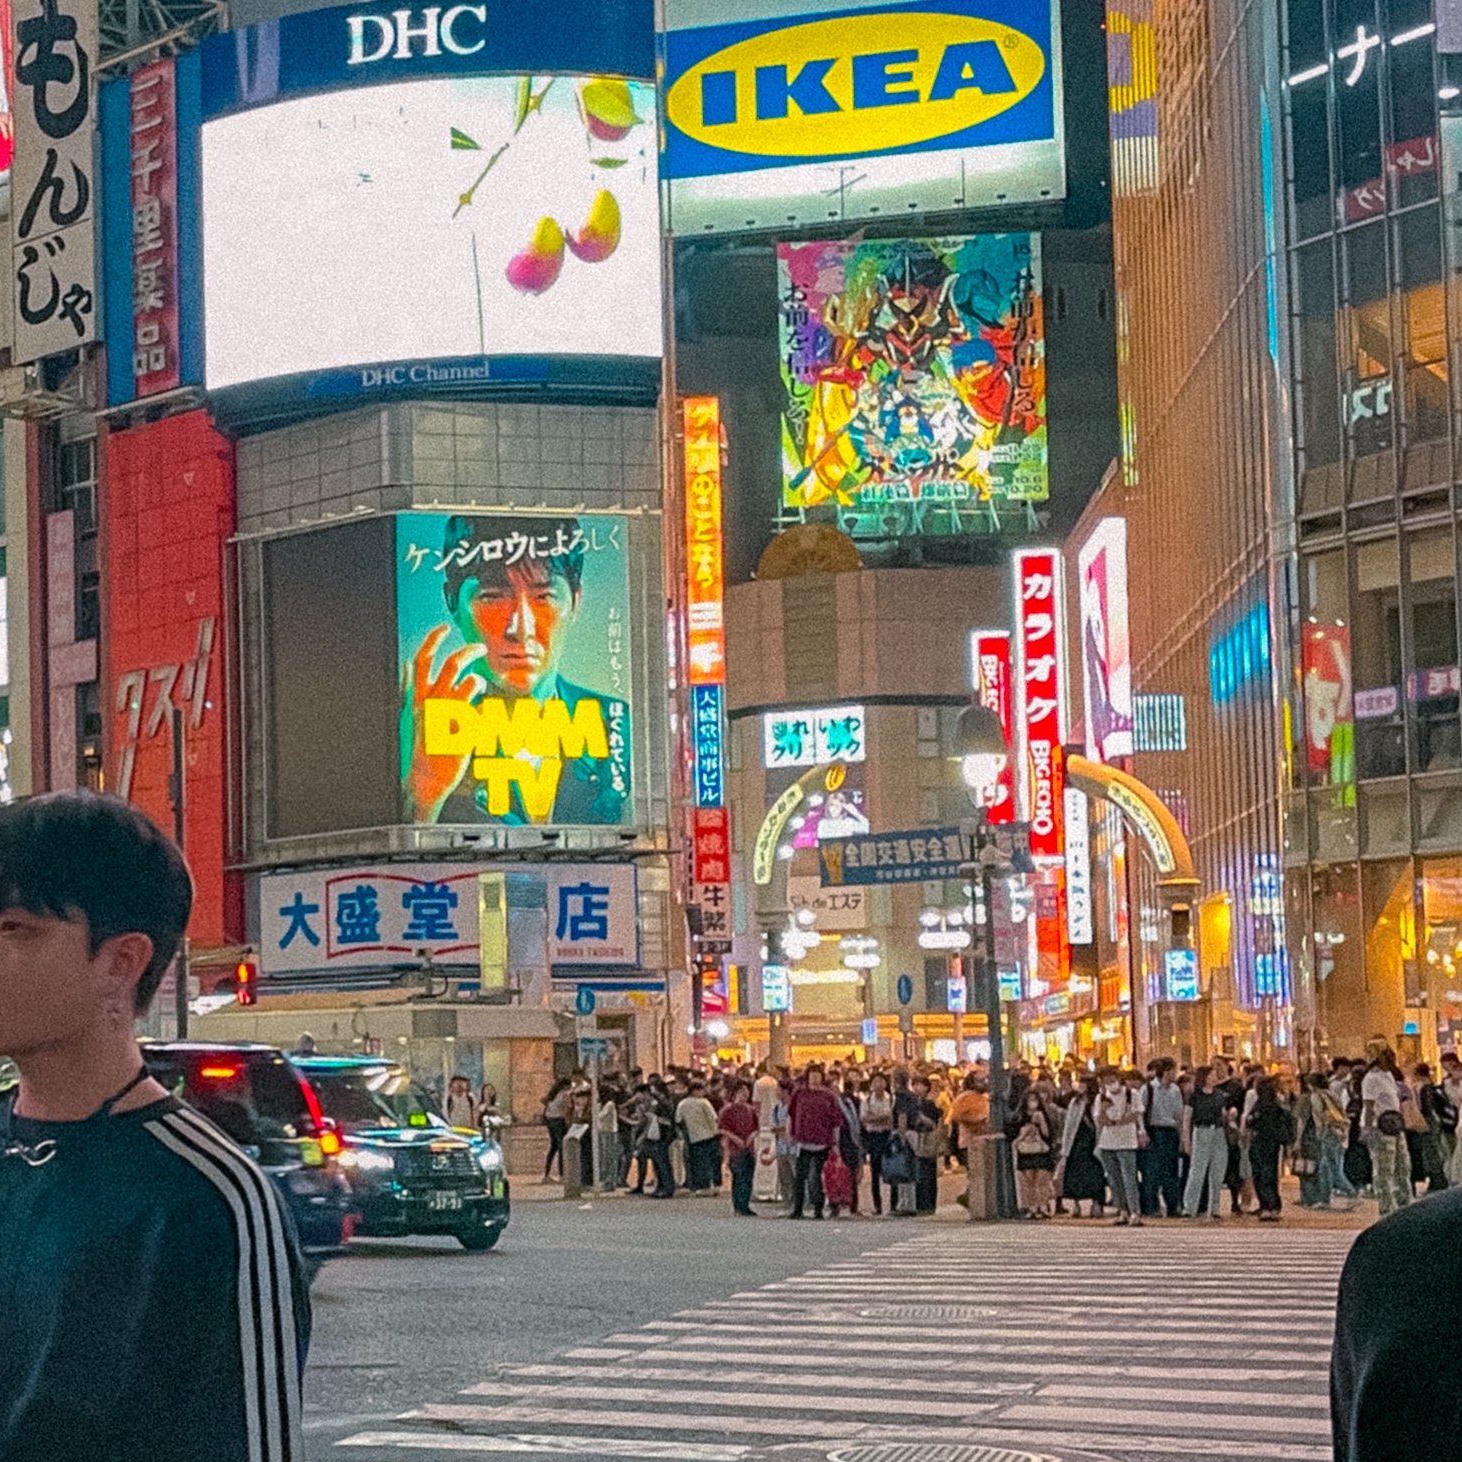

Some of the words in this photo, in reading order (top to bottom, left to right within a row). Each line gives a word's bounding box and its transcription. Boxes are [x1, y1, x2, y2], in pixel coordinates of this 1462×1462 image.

[346, 4, 487, 66] DHC
[701, 39, 1018, 127] IKEA
[16, 0, 92, 337] もんじゃ
[361, 367, 406, 388] DHC
[410, 361, 491, 383] Channel
[404, 525, 622, 573] ケンシロウによろしく
[1023, 572, 1058, 723] カラオケ
[424, 698, 609, 758] DMM
[473, 757, 562, 816] TV
[1033, 740, 1051, 779] BIG
[1034, 779, 1054, 836] ECHO
[278, 879, 611, 950] 大盛堂店
